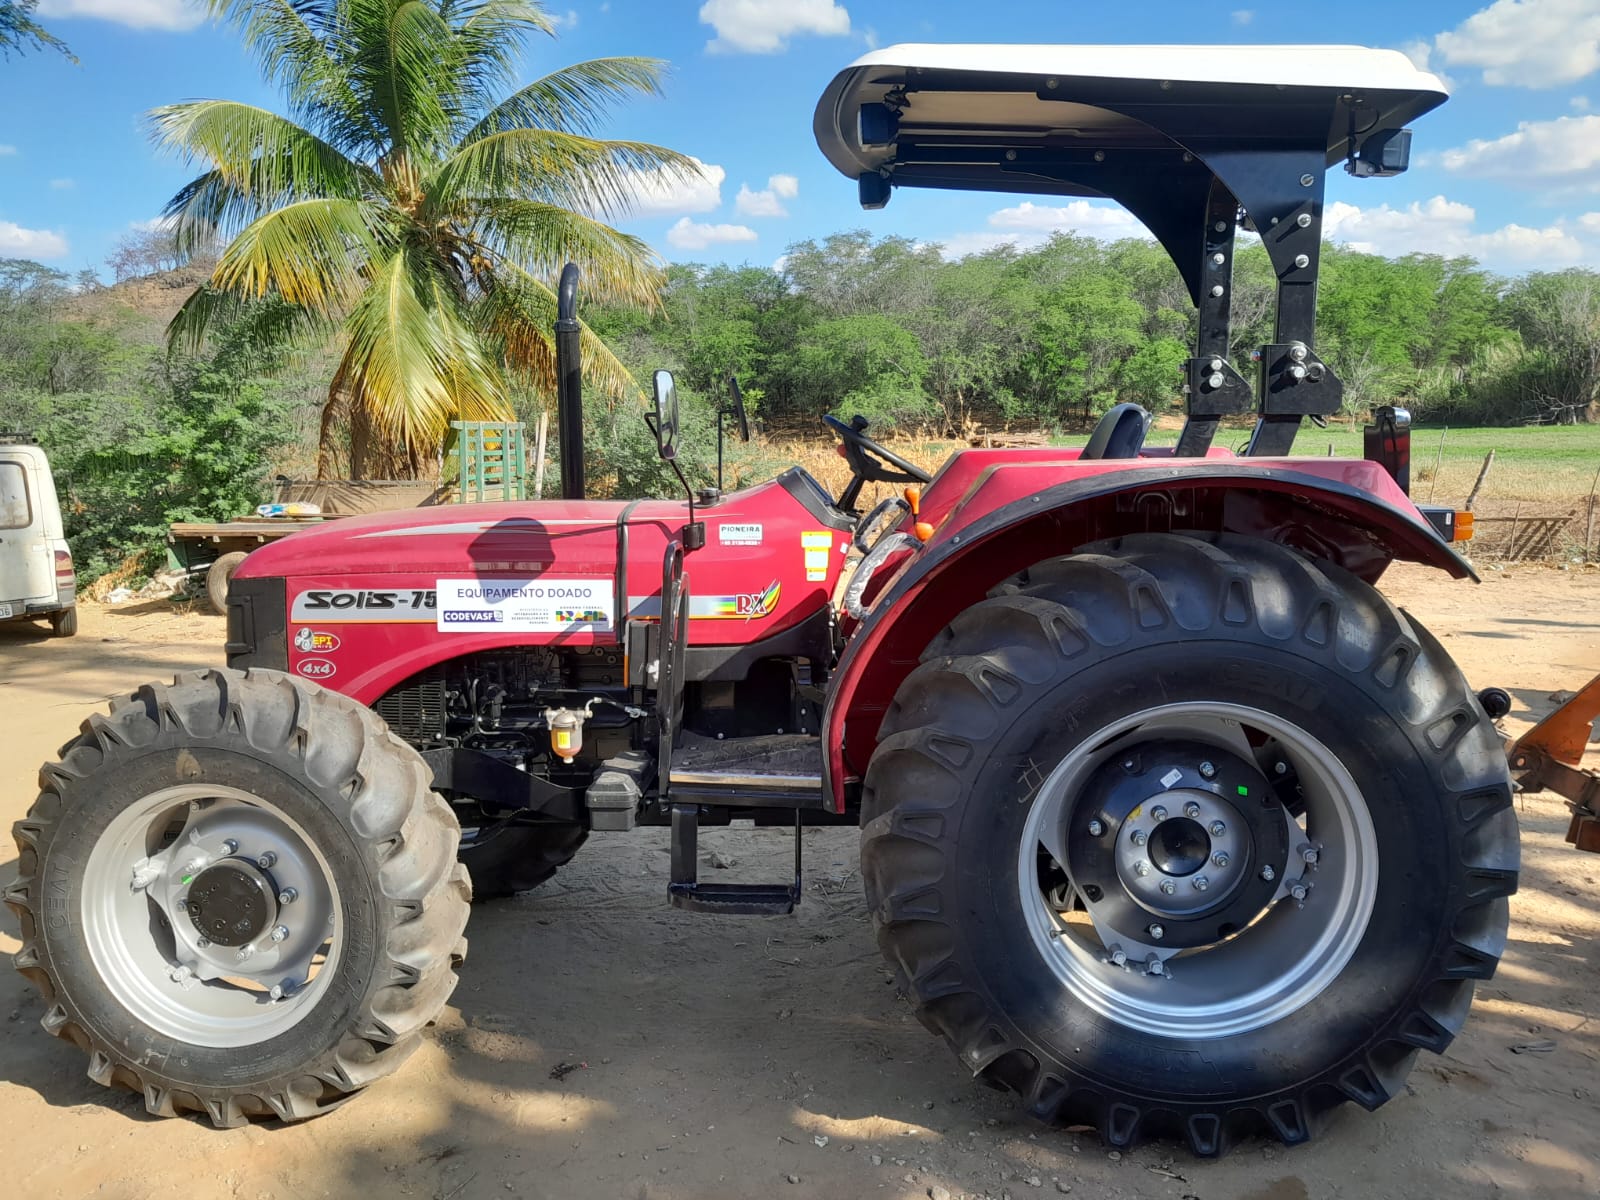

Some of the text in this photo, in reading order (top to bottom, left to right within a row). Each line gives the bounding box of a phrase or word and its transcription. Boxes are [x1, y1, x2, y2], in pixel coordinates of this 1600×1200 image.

[457, 588, 592, 598] EQUIPAMENTO DOADO
[444, 611, 495, 621] CODEVASF
[302, 663, 331, 674] 4x4
